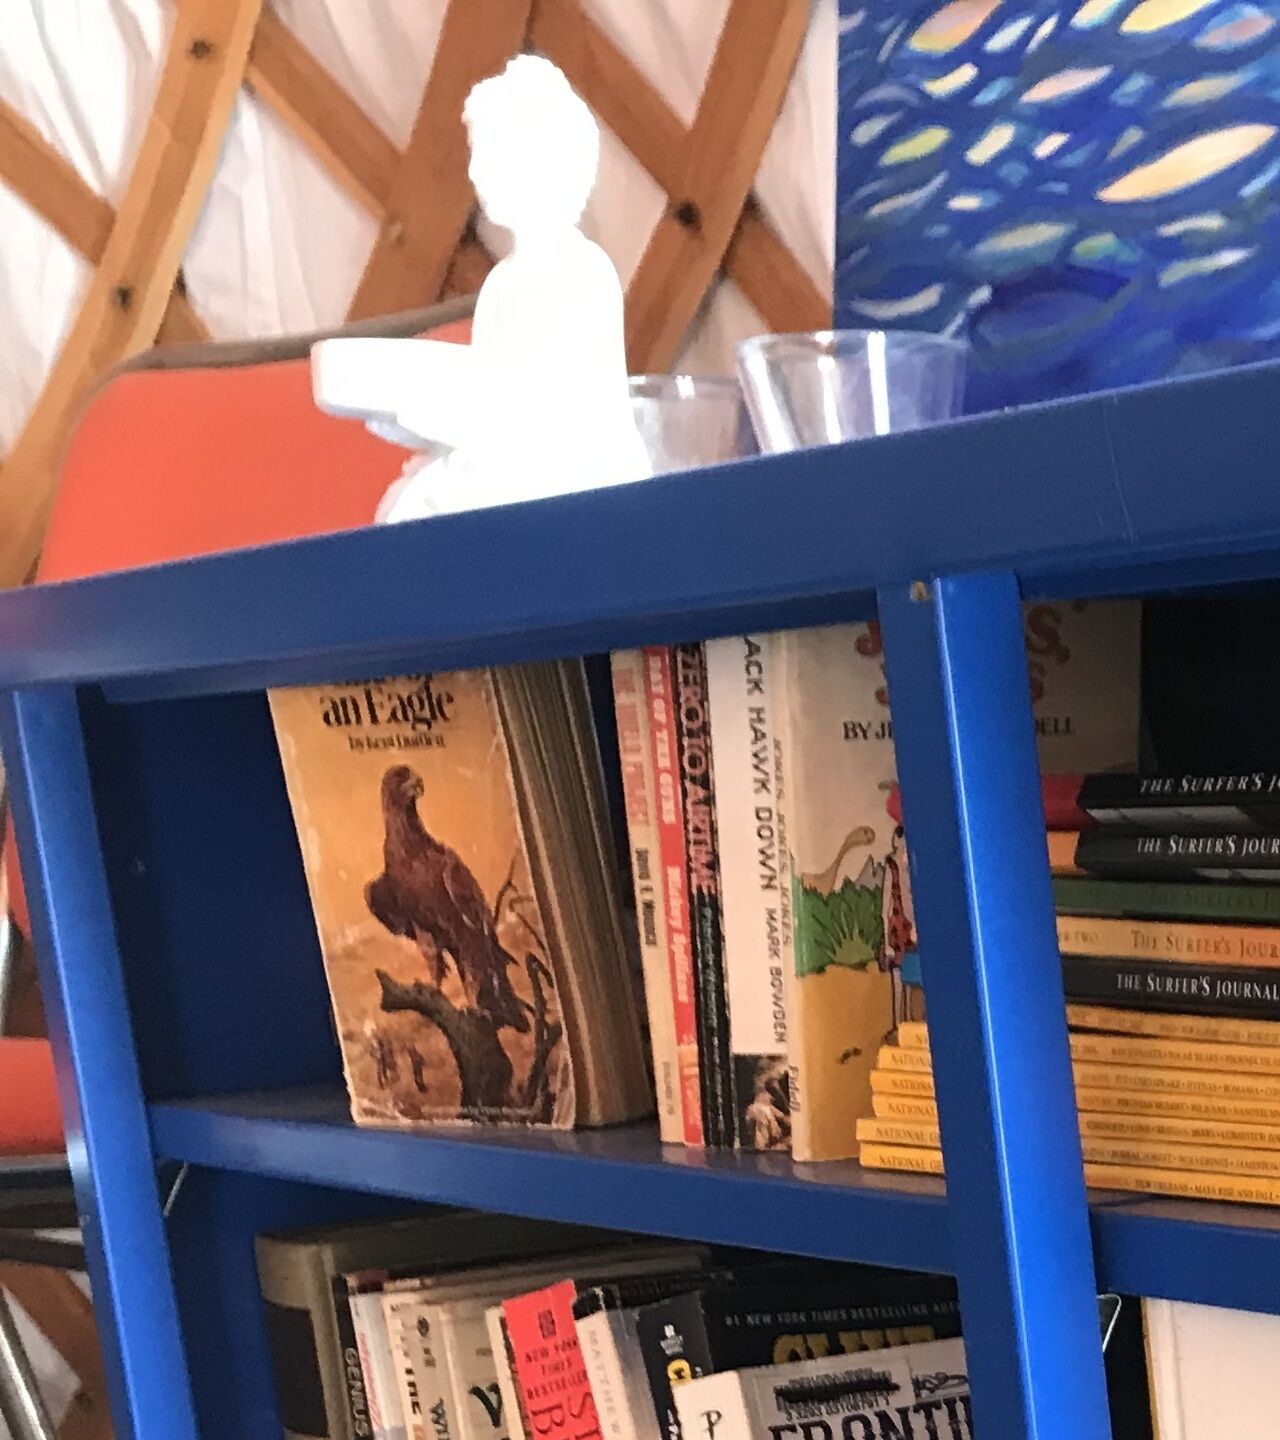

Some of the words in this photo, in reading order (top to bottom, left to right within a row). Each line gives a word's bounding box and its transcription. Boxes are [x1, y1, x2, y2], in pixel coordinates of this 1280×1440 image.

[320, 696, 363, 726] an
[364, 673, 455, 731] Eagle
[680, 651, 704, 731] ZERO
[655, 728, 671, 768] THE
[748, 707, 773, 795] HAWK
[843, 720, 871, 741] BY
[683, 736, 707, 776] TO
[659, 772, 677, 825] GUNS
[1139, 777, 1174, 794] THE
[1178, 771, 1265, 794] SURFER'S
[685, 779, 717, 895] AIRTIME
[754, 806, 779, 891] DOWN
[1137, 836, 1161, 853] THE
[1167, 834, 1237, 855] SURFER'S
[765, 907, 781, 961] MARK
[1131, 929, 1158, 949] THE
[1166, 931, 1231, 955] SURFER'S
[769, 966, 788, 1044] BOWDEN
[1116, 973, 1141, 990] THE
[1147, 972, 1211, 997] SURFER'S
[1216, 979, 1280, 1001] JOURNAL
[875, 1127, 926, 1141] NATIONAL
[878, 1155, 927, 1169] NATIONAL
[746, 1313, 772, 1326] NEW
[776, 1312, 807, 1325] YORK
[811, 1309, 846, 1322] TIMES
[851, 1304, 928, 1320] BESTSELLING
[344, 1347, 370, 1438] GENIUS
[588, 1329, 621, 1436] MATTHEW
